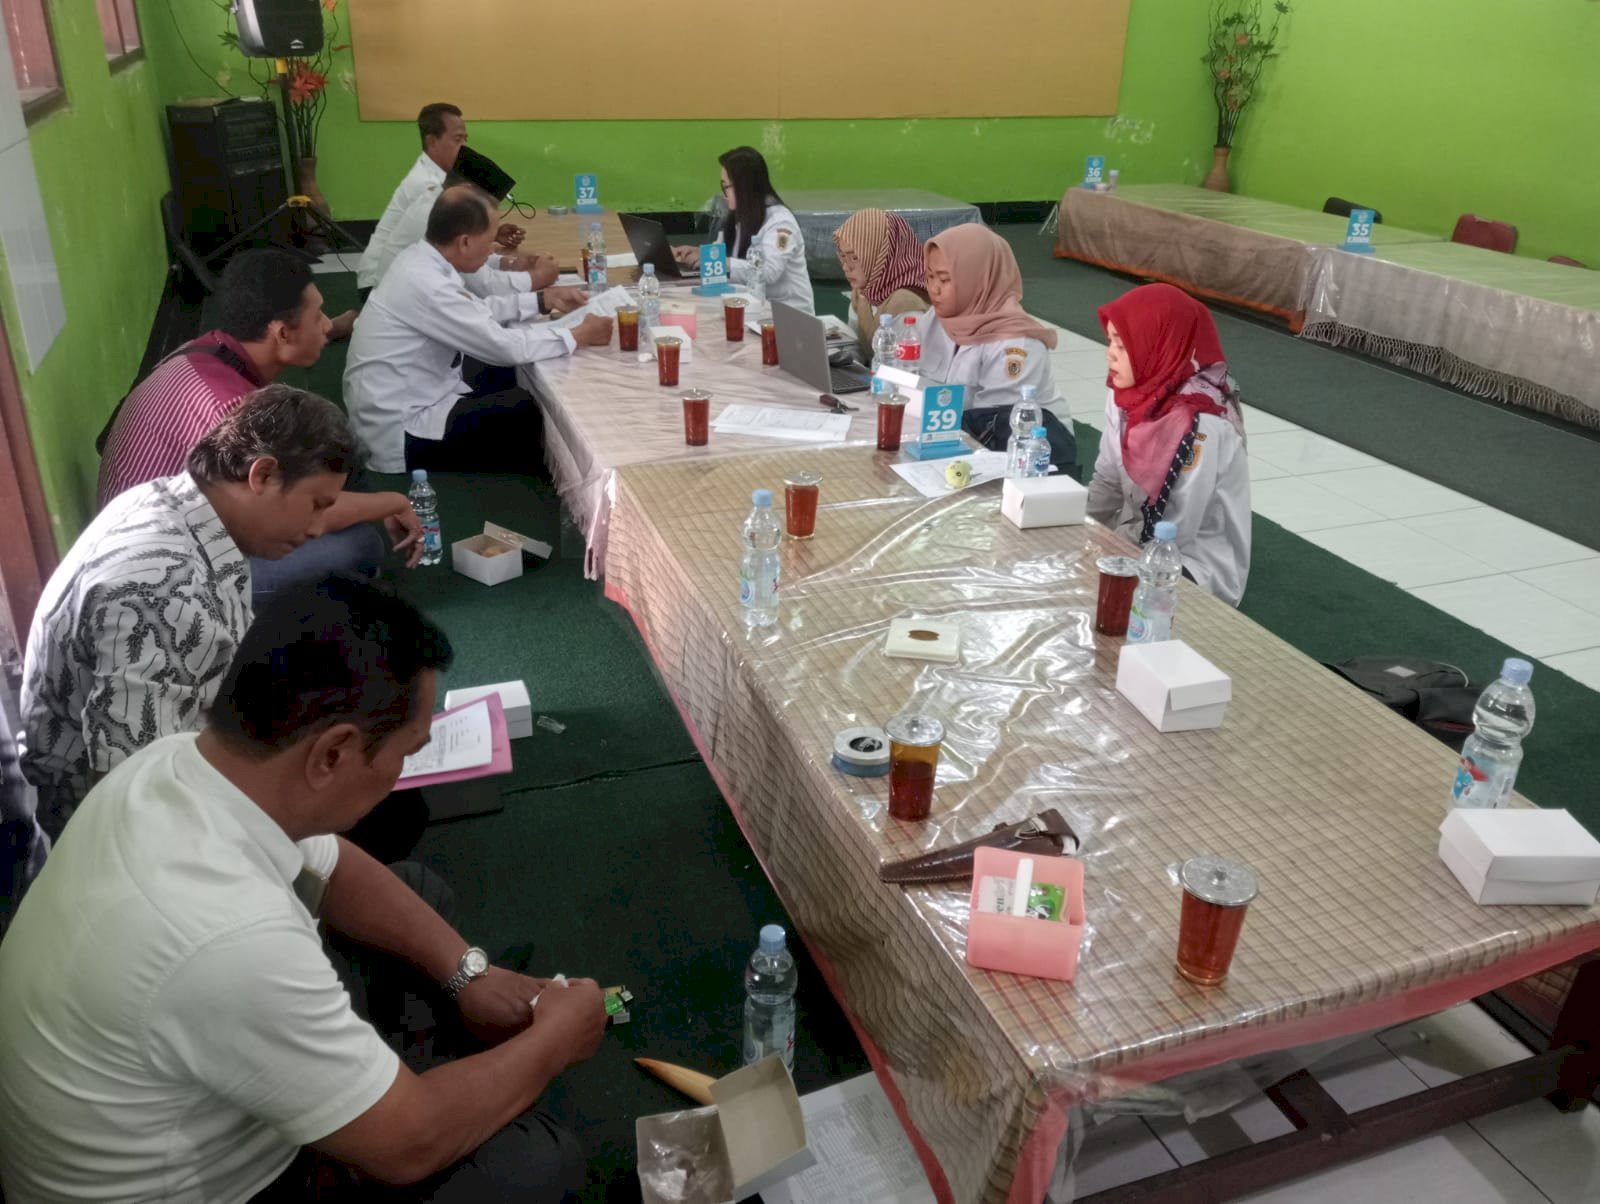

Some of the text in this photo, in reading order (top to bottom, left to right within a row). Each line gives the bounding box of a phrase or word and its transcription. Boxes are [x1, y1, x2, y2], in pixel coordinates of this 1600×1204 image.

[579, 187, 595, 198] 37
[1351, 223, 1370, 236] 35
[704, 261, 724, 276] 38
[926, 409, 957, 431] 39
